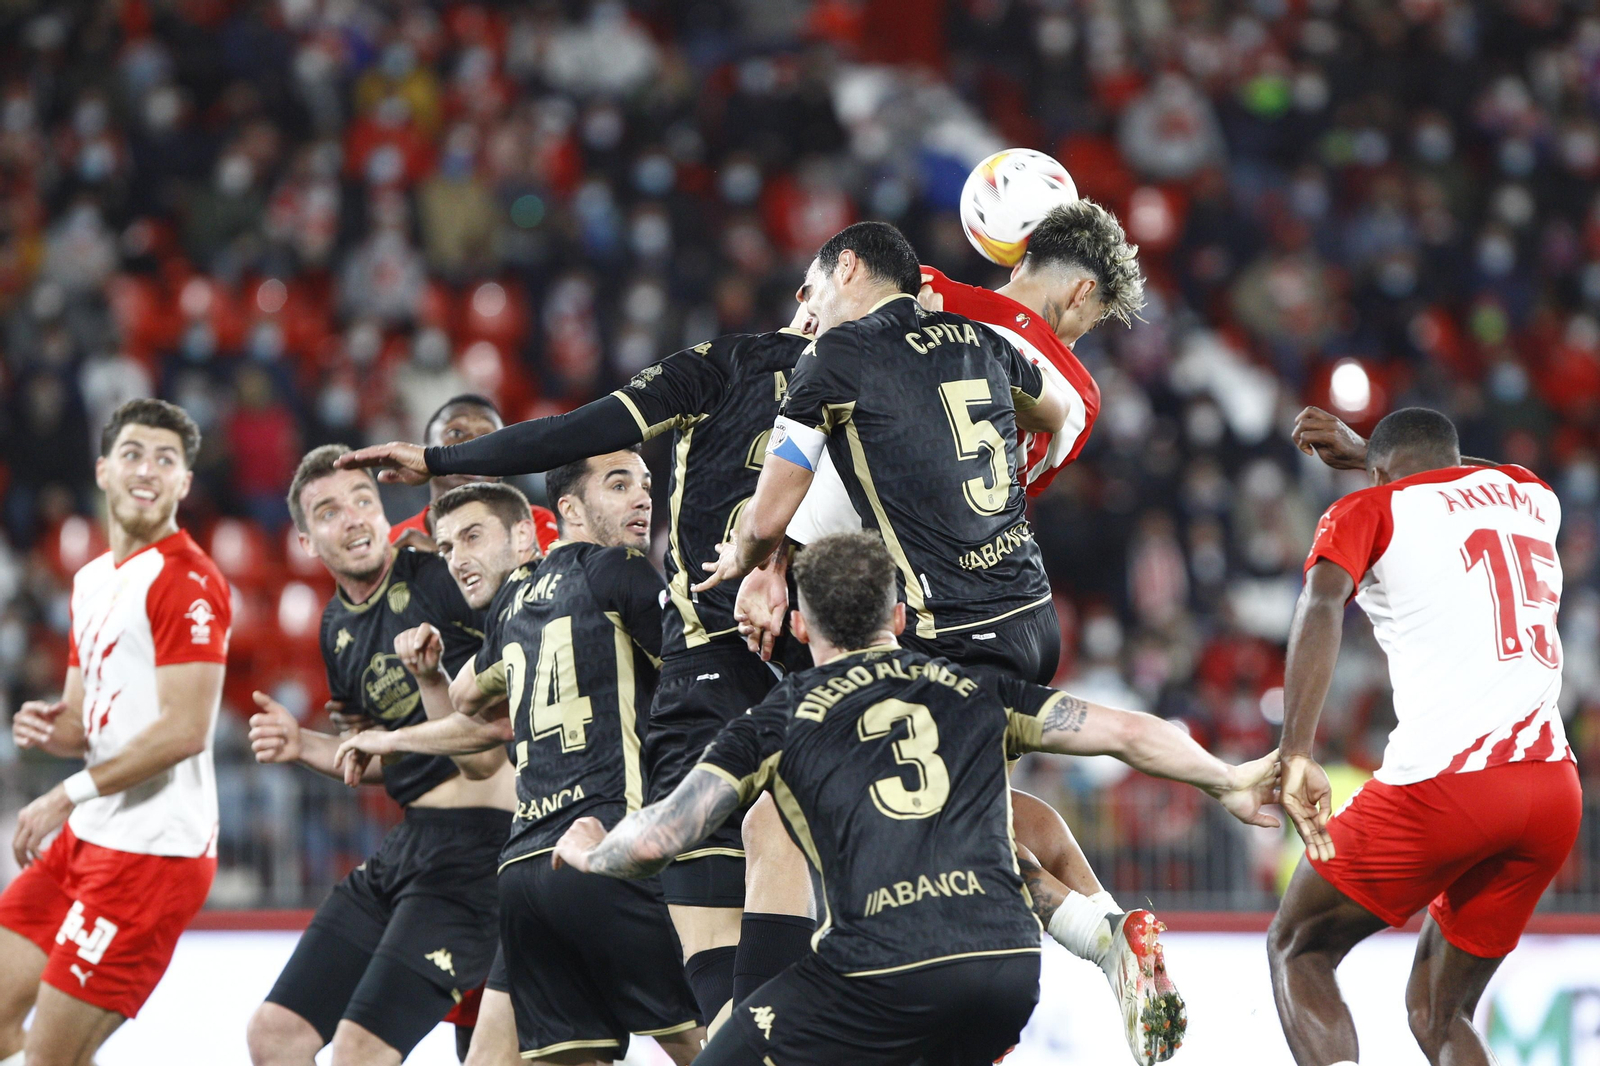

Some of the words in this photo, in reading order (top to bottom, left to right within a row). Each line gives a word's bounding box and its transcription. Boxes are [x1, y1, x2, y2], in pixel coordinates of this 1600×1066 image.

[905, 323, 981, 355] C.PITA
[938, 378, 1009, 517] 5
[1459, 527, 1560, 670] 15
[794, 664, 875, 724] DIEGO
[512, 784, 585, 824] BANCA
[857, 698, 950, 820] 3
